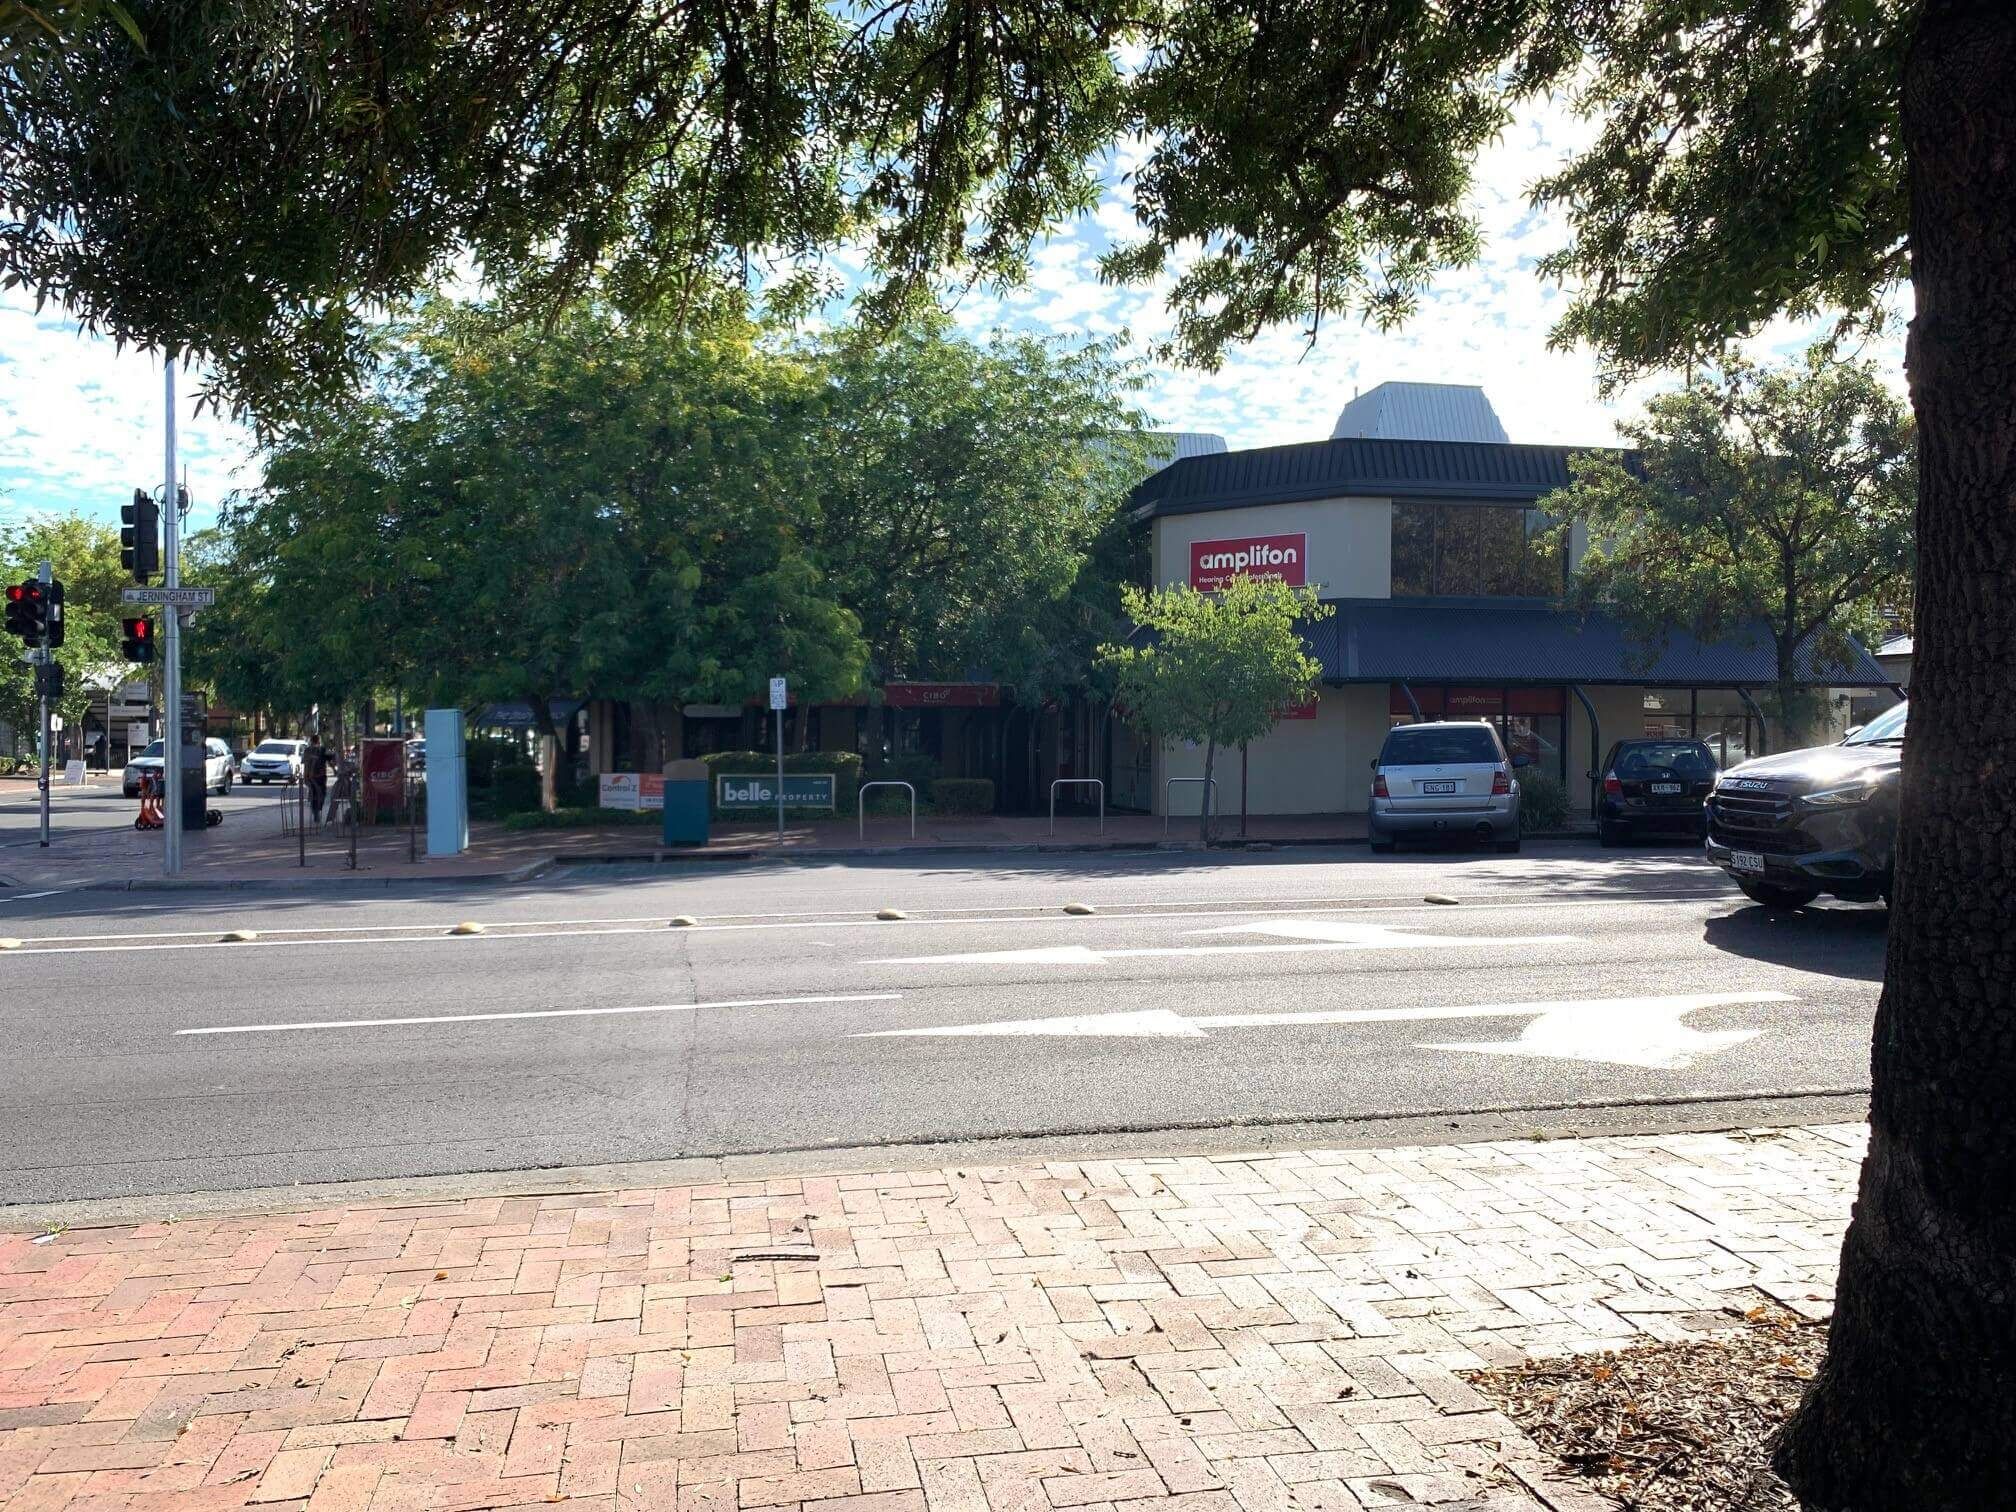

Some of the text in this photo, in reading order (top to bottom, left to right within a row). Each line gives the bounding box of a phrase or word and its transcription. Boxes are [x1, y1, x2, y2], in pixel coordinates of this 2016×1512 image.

[1200, 544, 1297, 573] amplifon
[1199, 576, 1224, 584] Hearing
[137, 591, 209, 602] JERNINGHAM ST
[1449, 696, 1487, 707] amplifon
[601, 784, 631, 792] Control
[1739, 781, 1768, 790] ISUZU
[725, 782, 828, 801] belle PROPERTY
